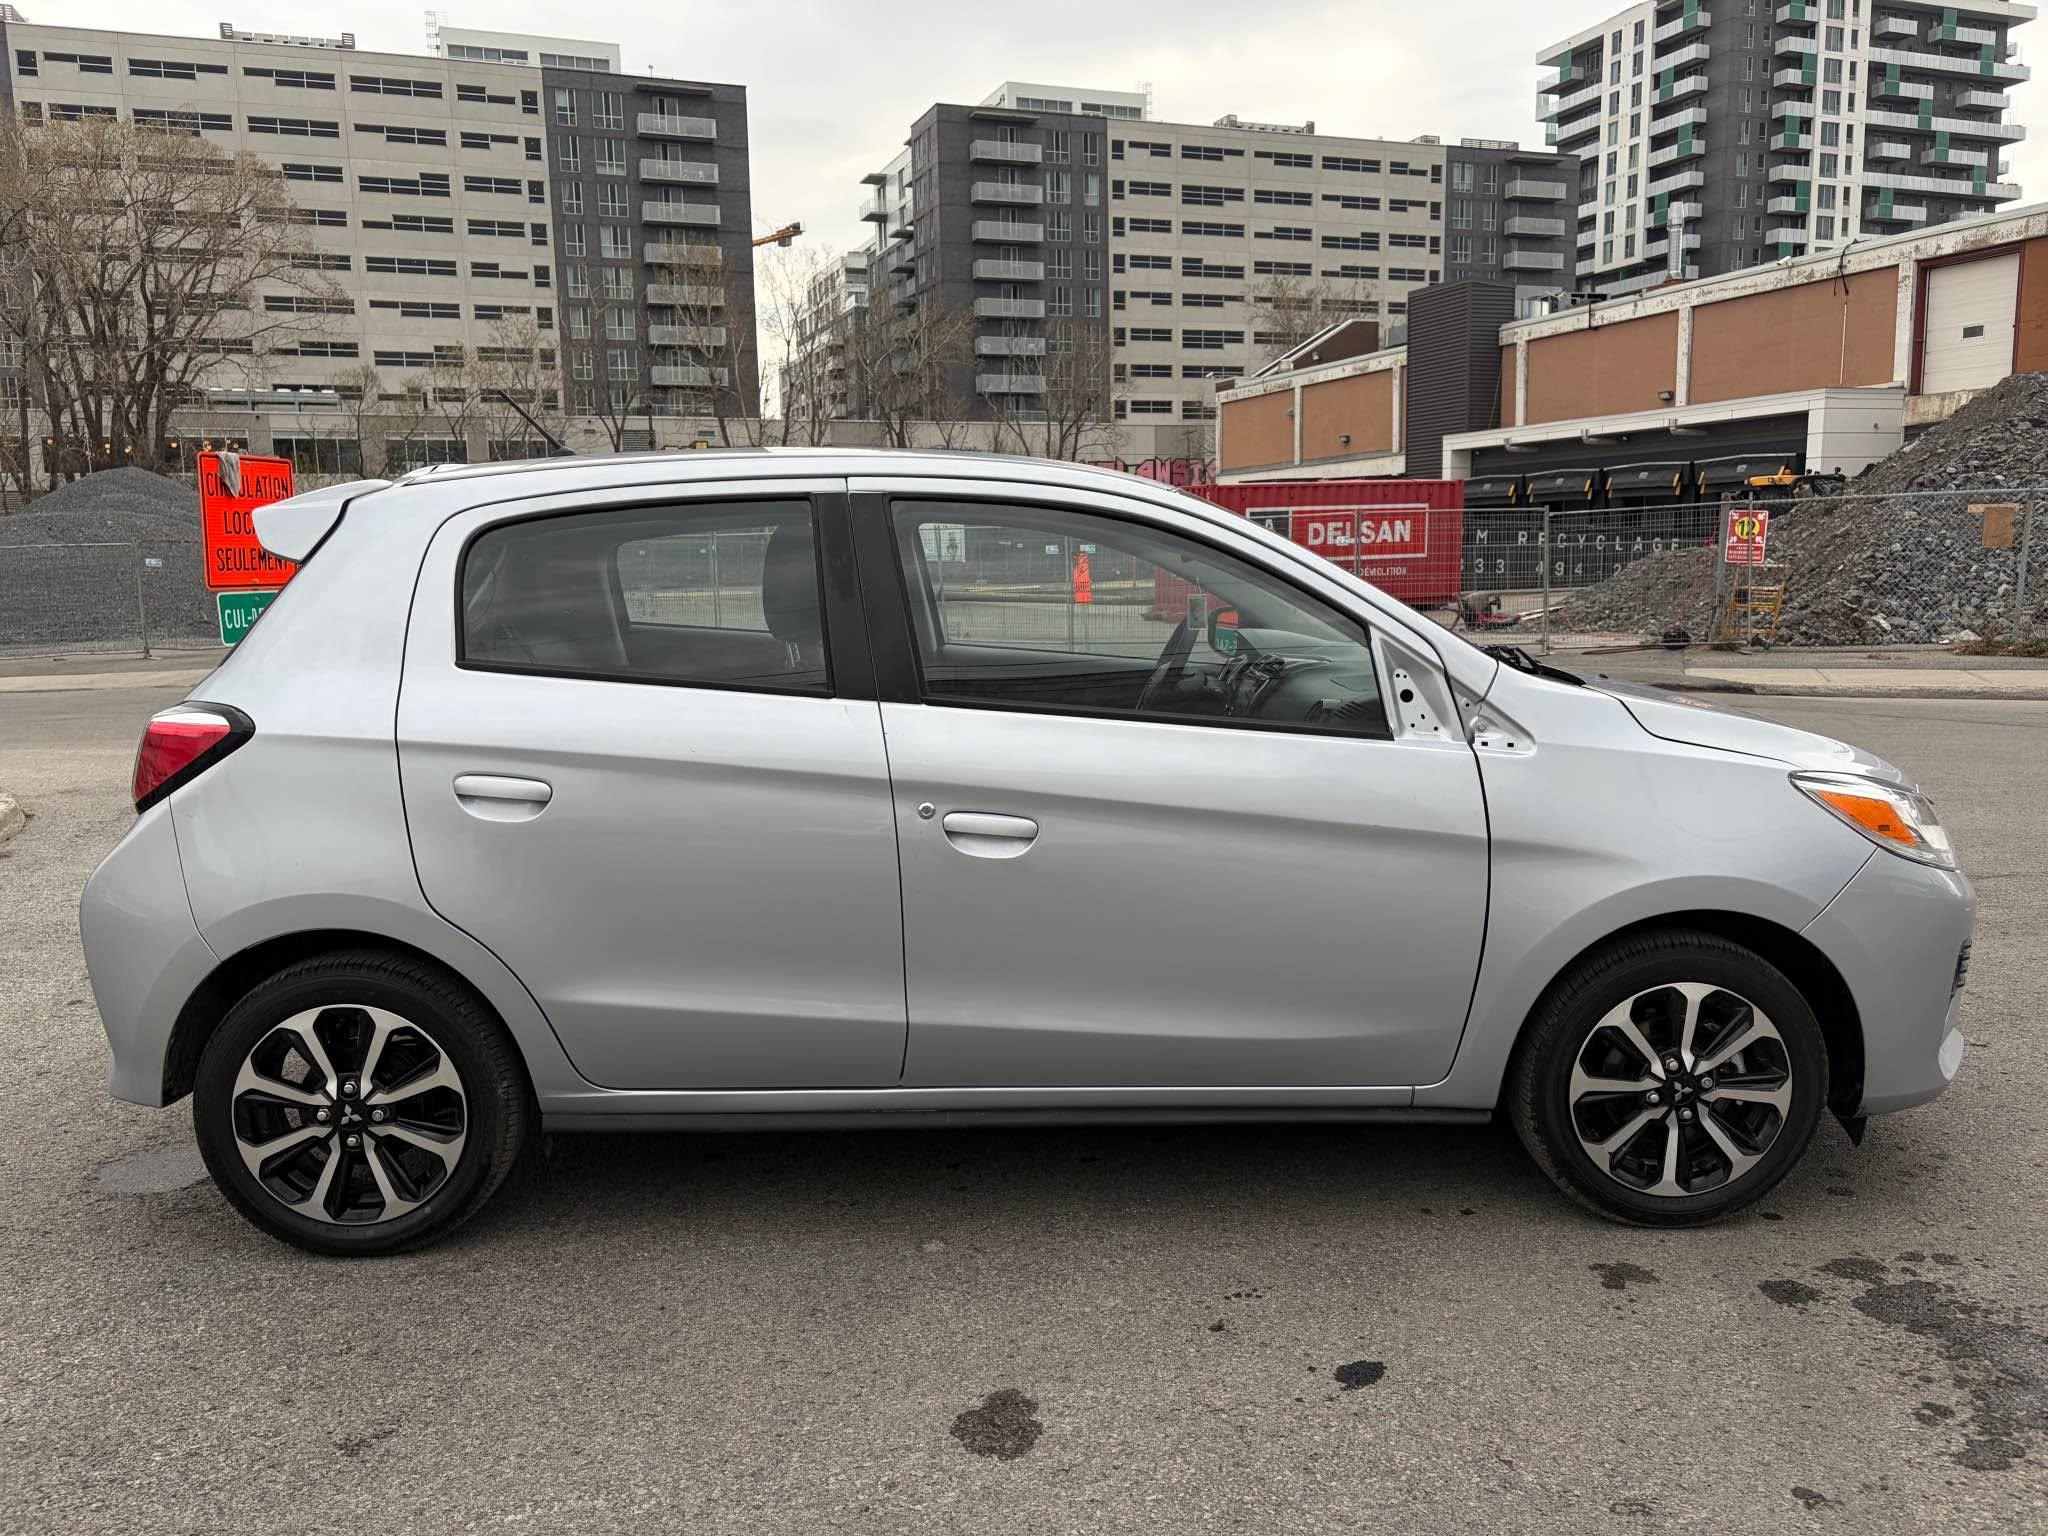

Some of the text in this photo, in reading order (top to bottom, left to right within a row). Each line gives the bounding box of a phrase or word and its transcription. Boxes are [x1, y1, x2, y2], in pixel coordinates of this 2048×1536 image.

[206, 472, 289, 499] CIULATION
[224, 510, 256, 534] LOC
[1307, 520, 1411, 546] DELSAN
[1738, 519, 1756, 536] 12
[1518, 531, 1680, 552] RECYCLAGE
[224, 607, 265, 629] CUL-D
